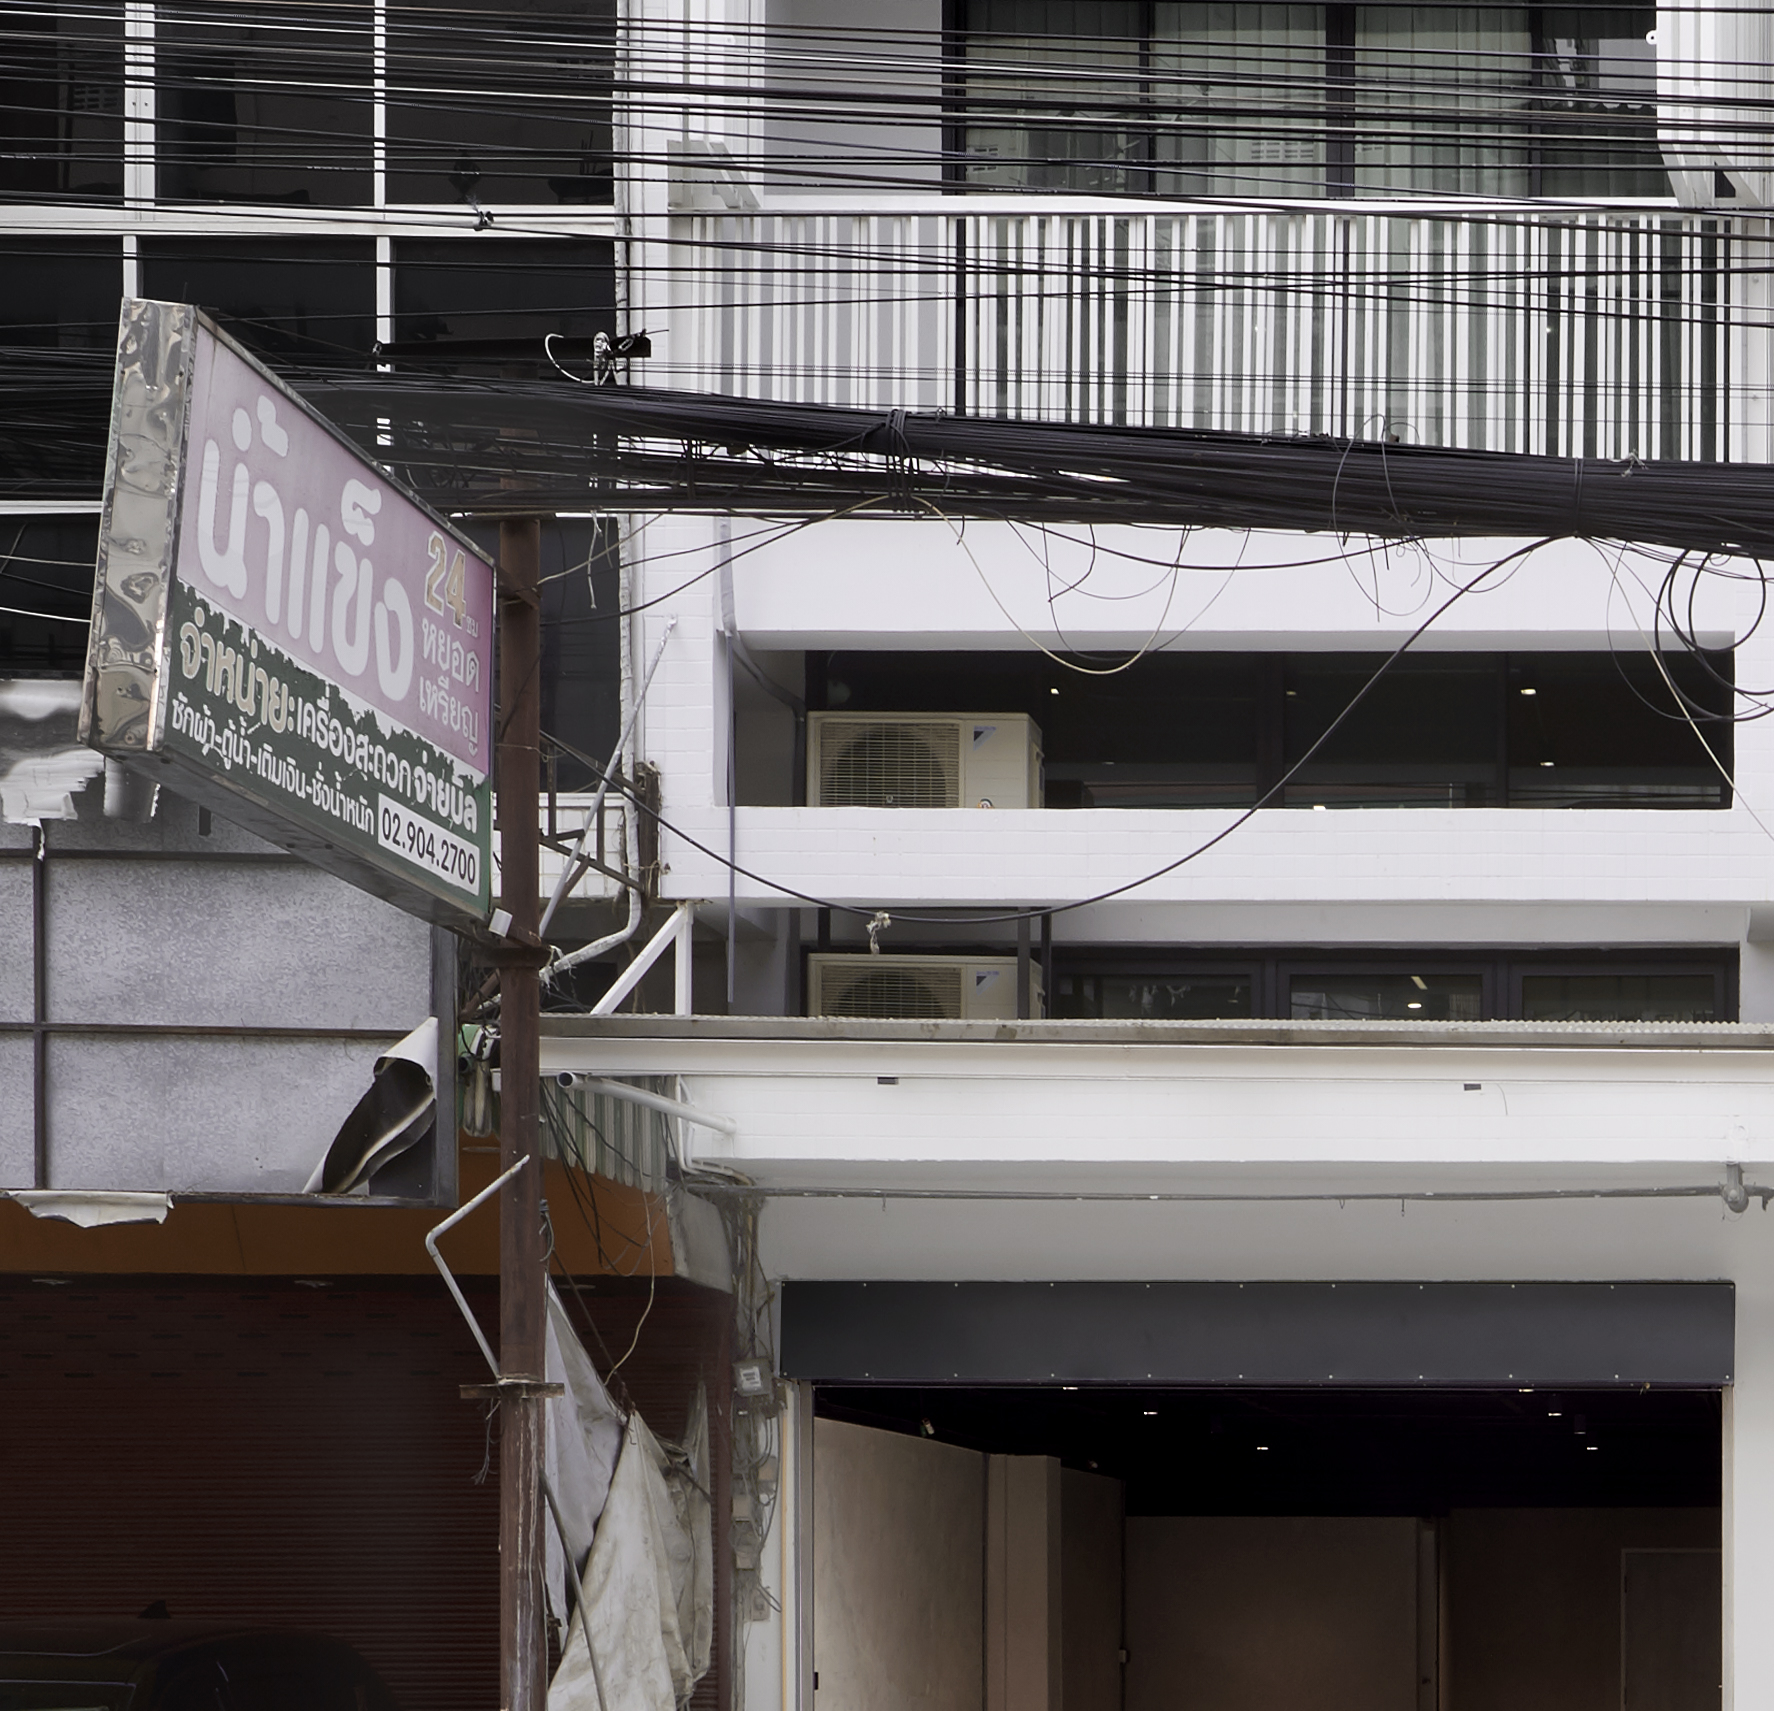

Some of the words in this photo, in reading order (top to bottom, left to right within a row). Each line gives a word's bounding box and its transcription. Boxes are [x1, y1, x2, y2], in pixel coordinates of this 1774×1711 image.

[198, 395, 413, 701] น้ำแข็ง
[424, 530, 467, 630] 24
[421, 617, 479, 692] หยอด
[419, 675, 479, 756] เหรียญ
[382, 807, 476, 885] 02.904.2700
